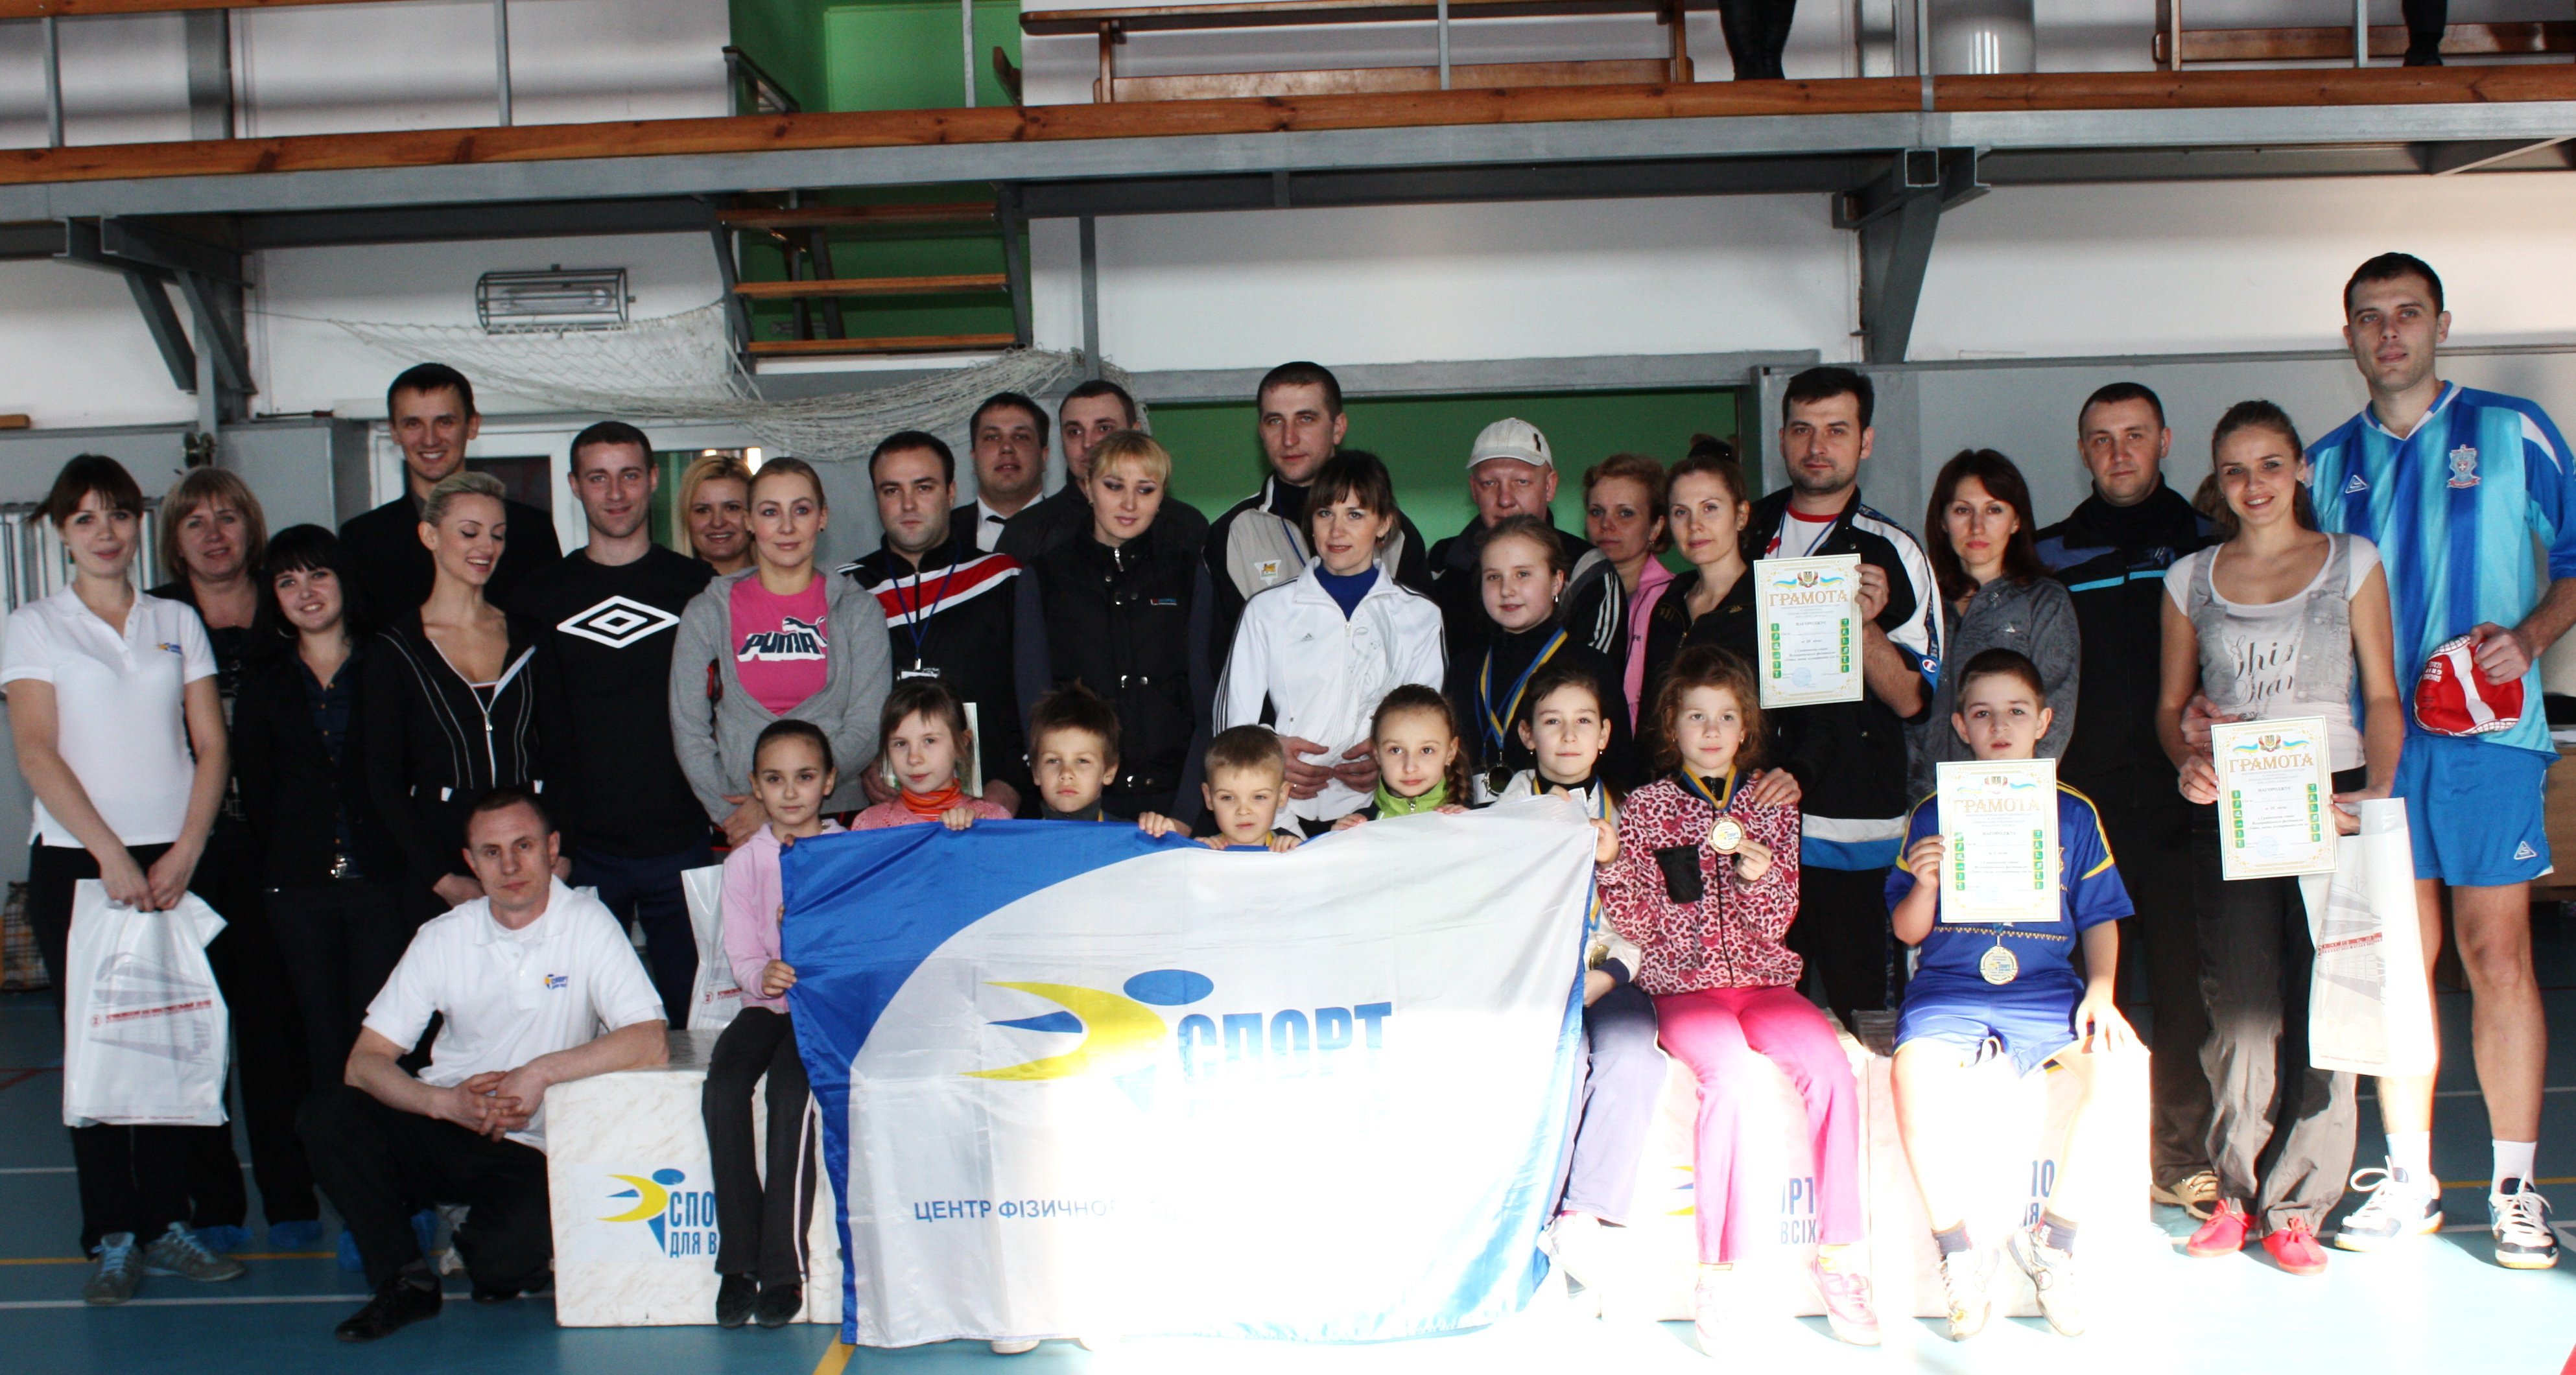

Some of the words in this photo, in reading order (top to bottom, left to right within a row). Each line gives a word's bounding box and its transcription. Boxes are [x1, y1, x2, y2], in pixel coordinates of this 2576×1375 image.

[1769, 590, 1848, 605] ГРАМОТА
[738, 631, 823, 660] PUMA
[2229, 753, 2314, 773] ГРАМОТА
[1953, 798, 2041, 813] ГРАМОТА
[1177, 1001, 1392, 1081] СПОРТ
[1781, 1177, 1814, 1214] РТ
[670, 1191, 715, 1227] СПО
[914, 1200, 992, 1222] ЦЕНТР
[670, 1232, 702, 1258] ДЛЯ
[709, 1232, 718, 1255] В
